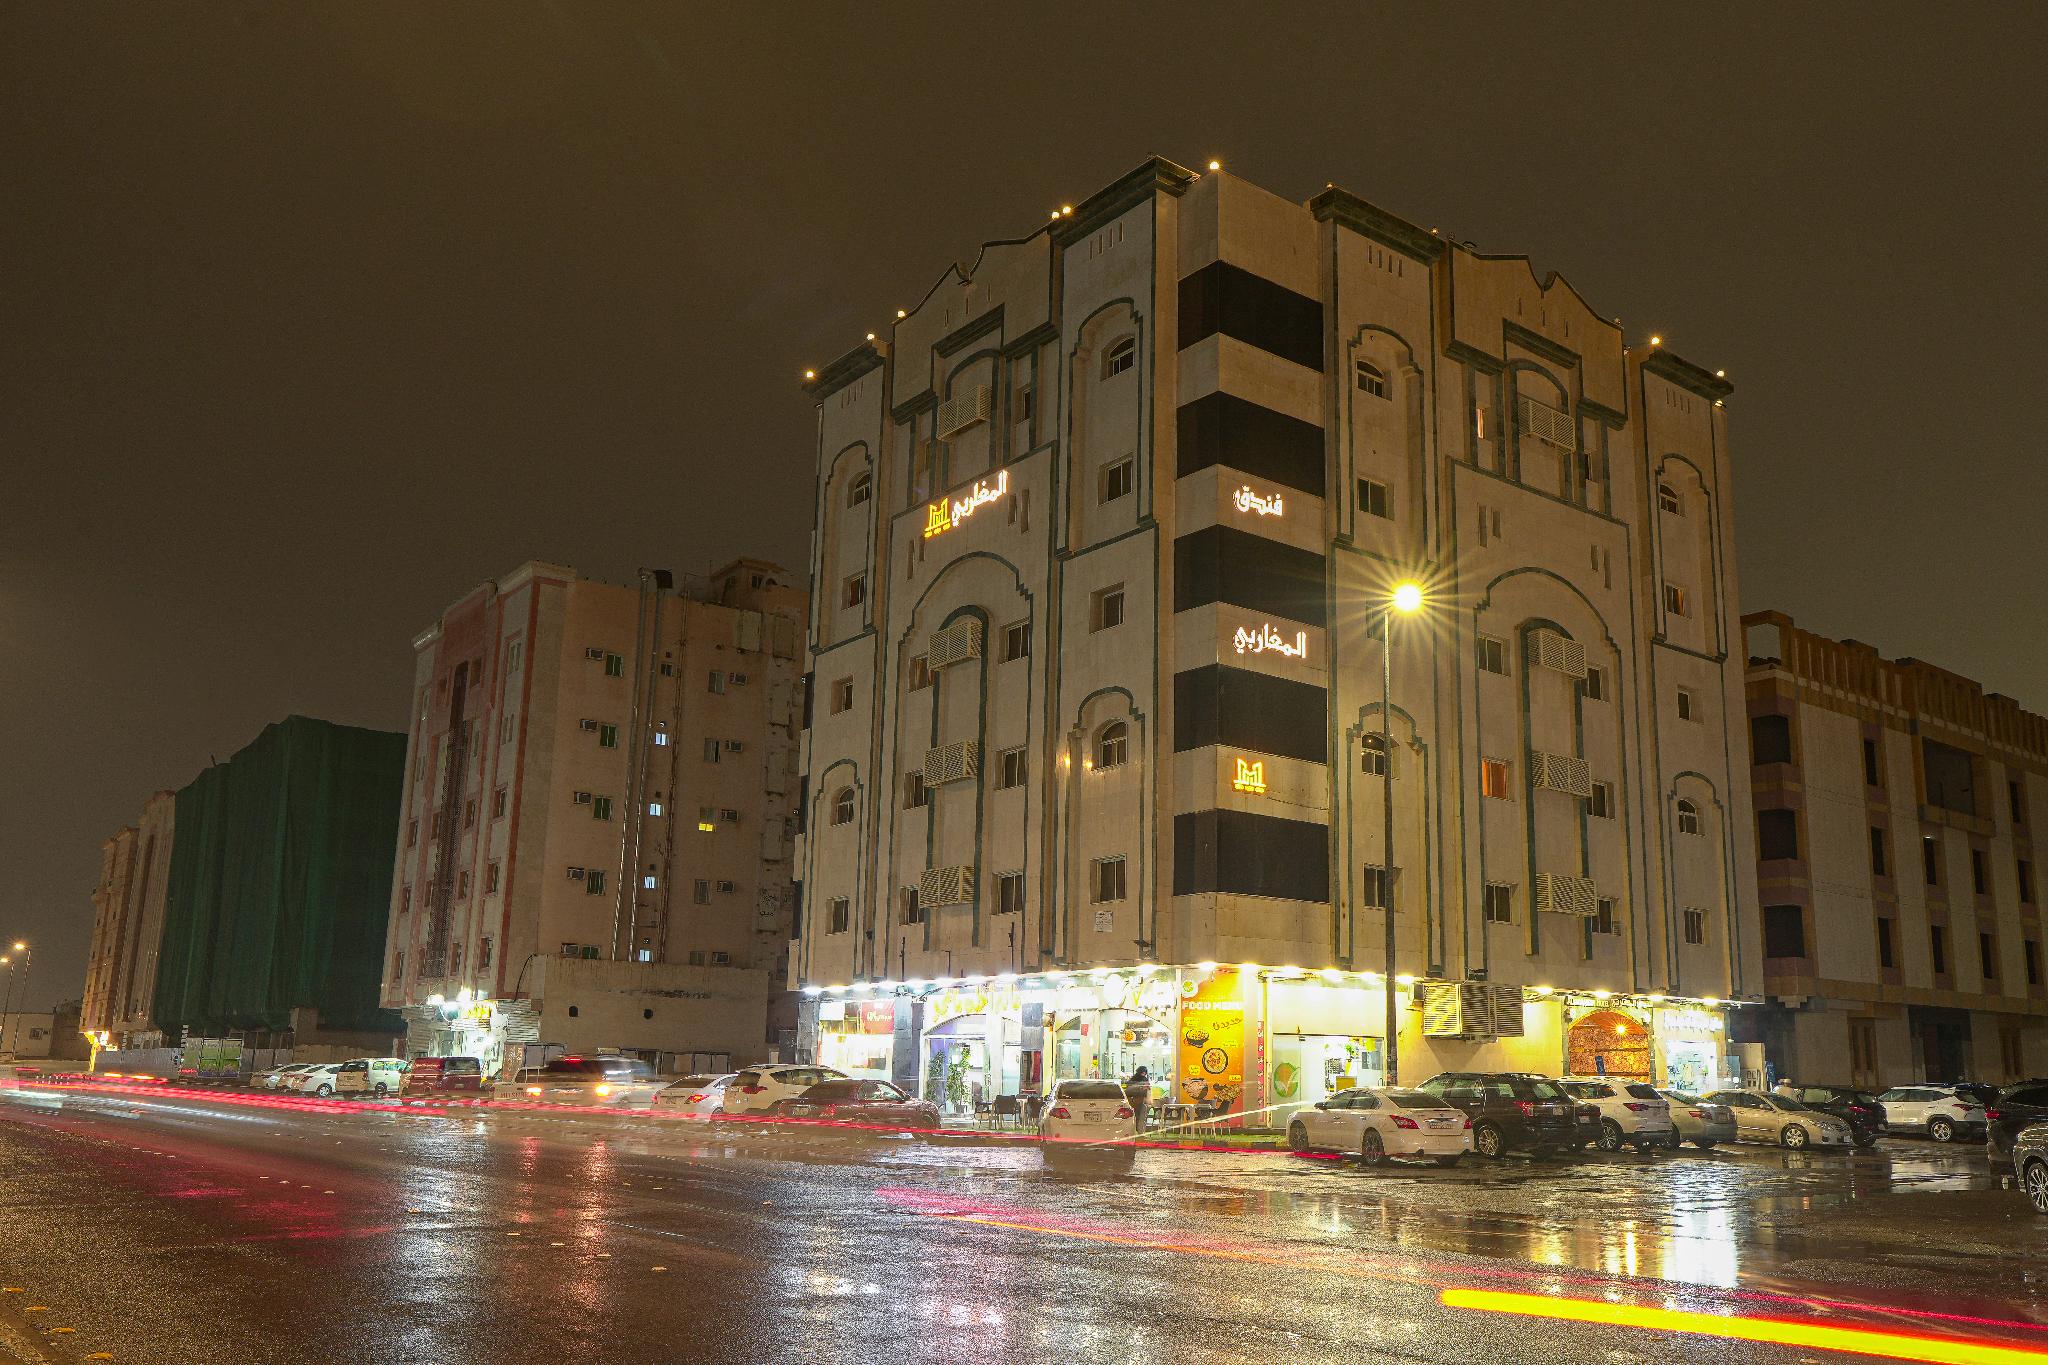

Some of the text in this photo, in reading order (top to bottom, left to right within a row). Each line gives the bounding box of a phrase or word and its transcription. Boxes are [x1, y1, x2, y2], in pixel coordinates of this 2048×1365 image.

[951, 469, 1008, 528] المغاربي
[1233, 485, 1283, 516] فندق
[1233, 623, 1307, 658] المغاربي
